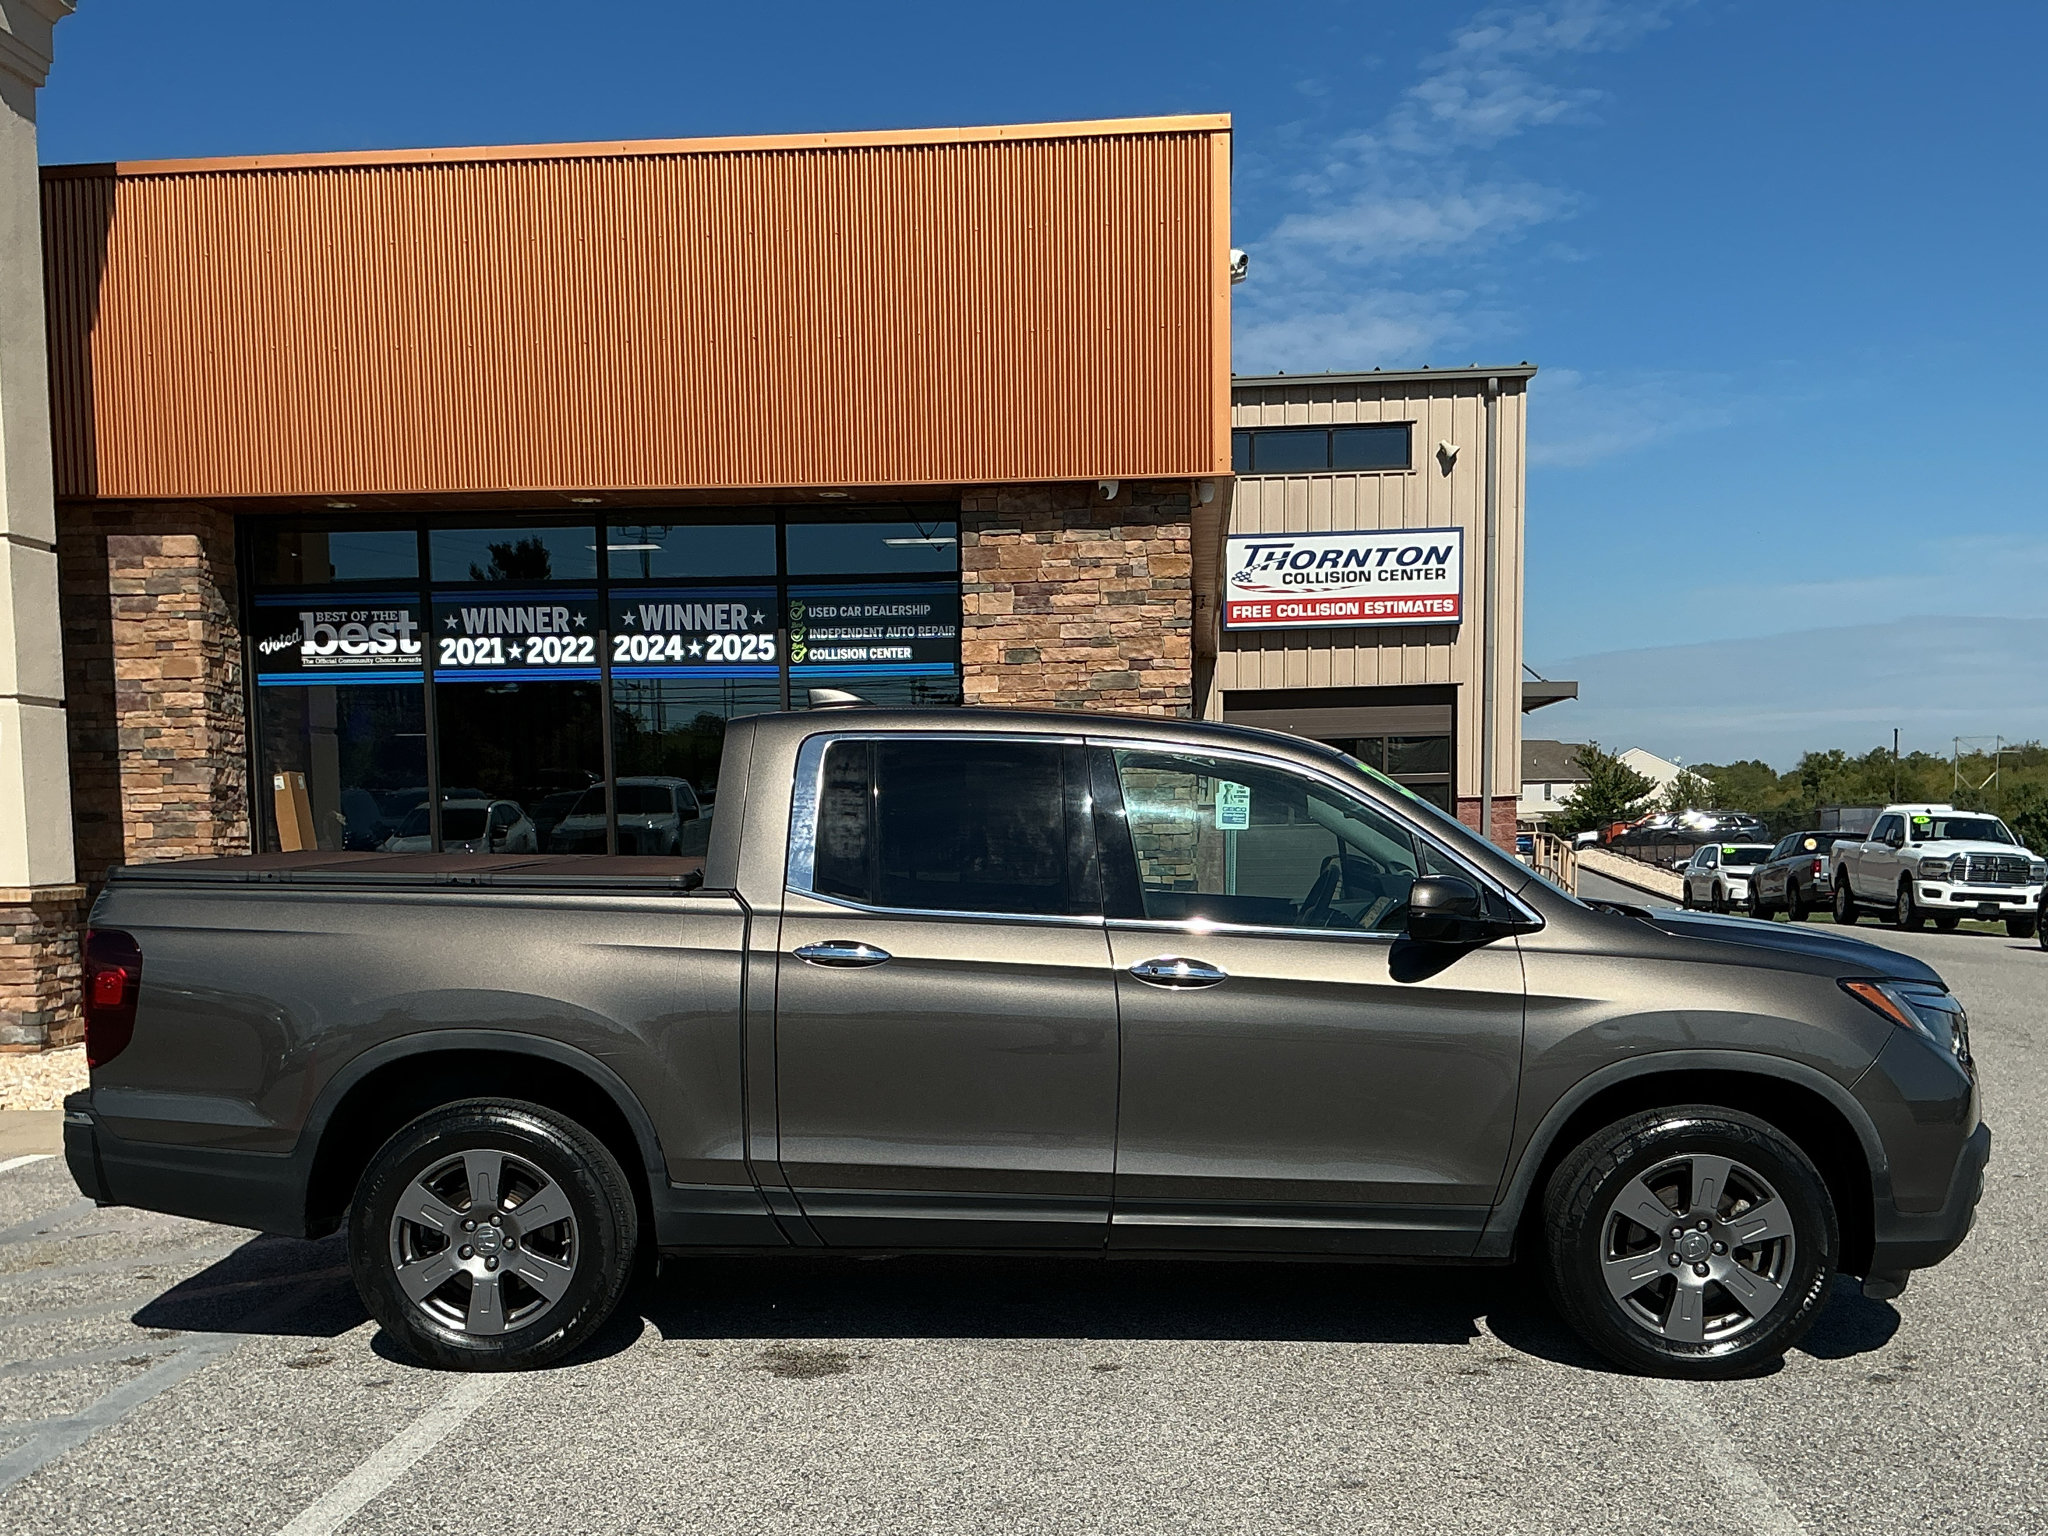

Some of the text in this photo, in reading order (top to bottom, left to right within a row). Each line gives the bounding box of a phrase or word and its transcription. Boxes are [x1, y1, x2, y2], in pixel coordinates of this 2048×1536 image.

[1244, 543, 1454, 571] THORNTON
[1282, 568, 1447, 585] COLLISION CENTER
[316, 610, 398, 623] BEST OF THE
[638, 603, 749, 631] WINNER
[808, 604, 931, 618] USED CAR DEALERSHIP
[1232, 599, 1454, 618] FREE COLLISION ESTIMATES
[461, 606, 570, 635] WINNER
[809, 625, 956, 639] INDEPENDENT AUTO REPAIR
[259, 627, 303, 655] Voted
[299, 610, 422, 655] best
[439, 636, 596, 665] 2021 2022
[613, 633, 776, 662] 2024 2025
[809, 647, 912, 660] COLLISION CENTER
[315, 657, 337, 665] Official
[338, 657, 374, 666] Community
[375, 656, 397, 664] Choice
[398, 656, 423, 664] Awards
